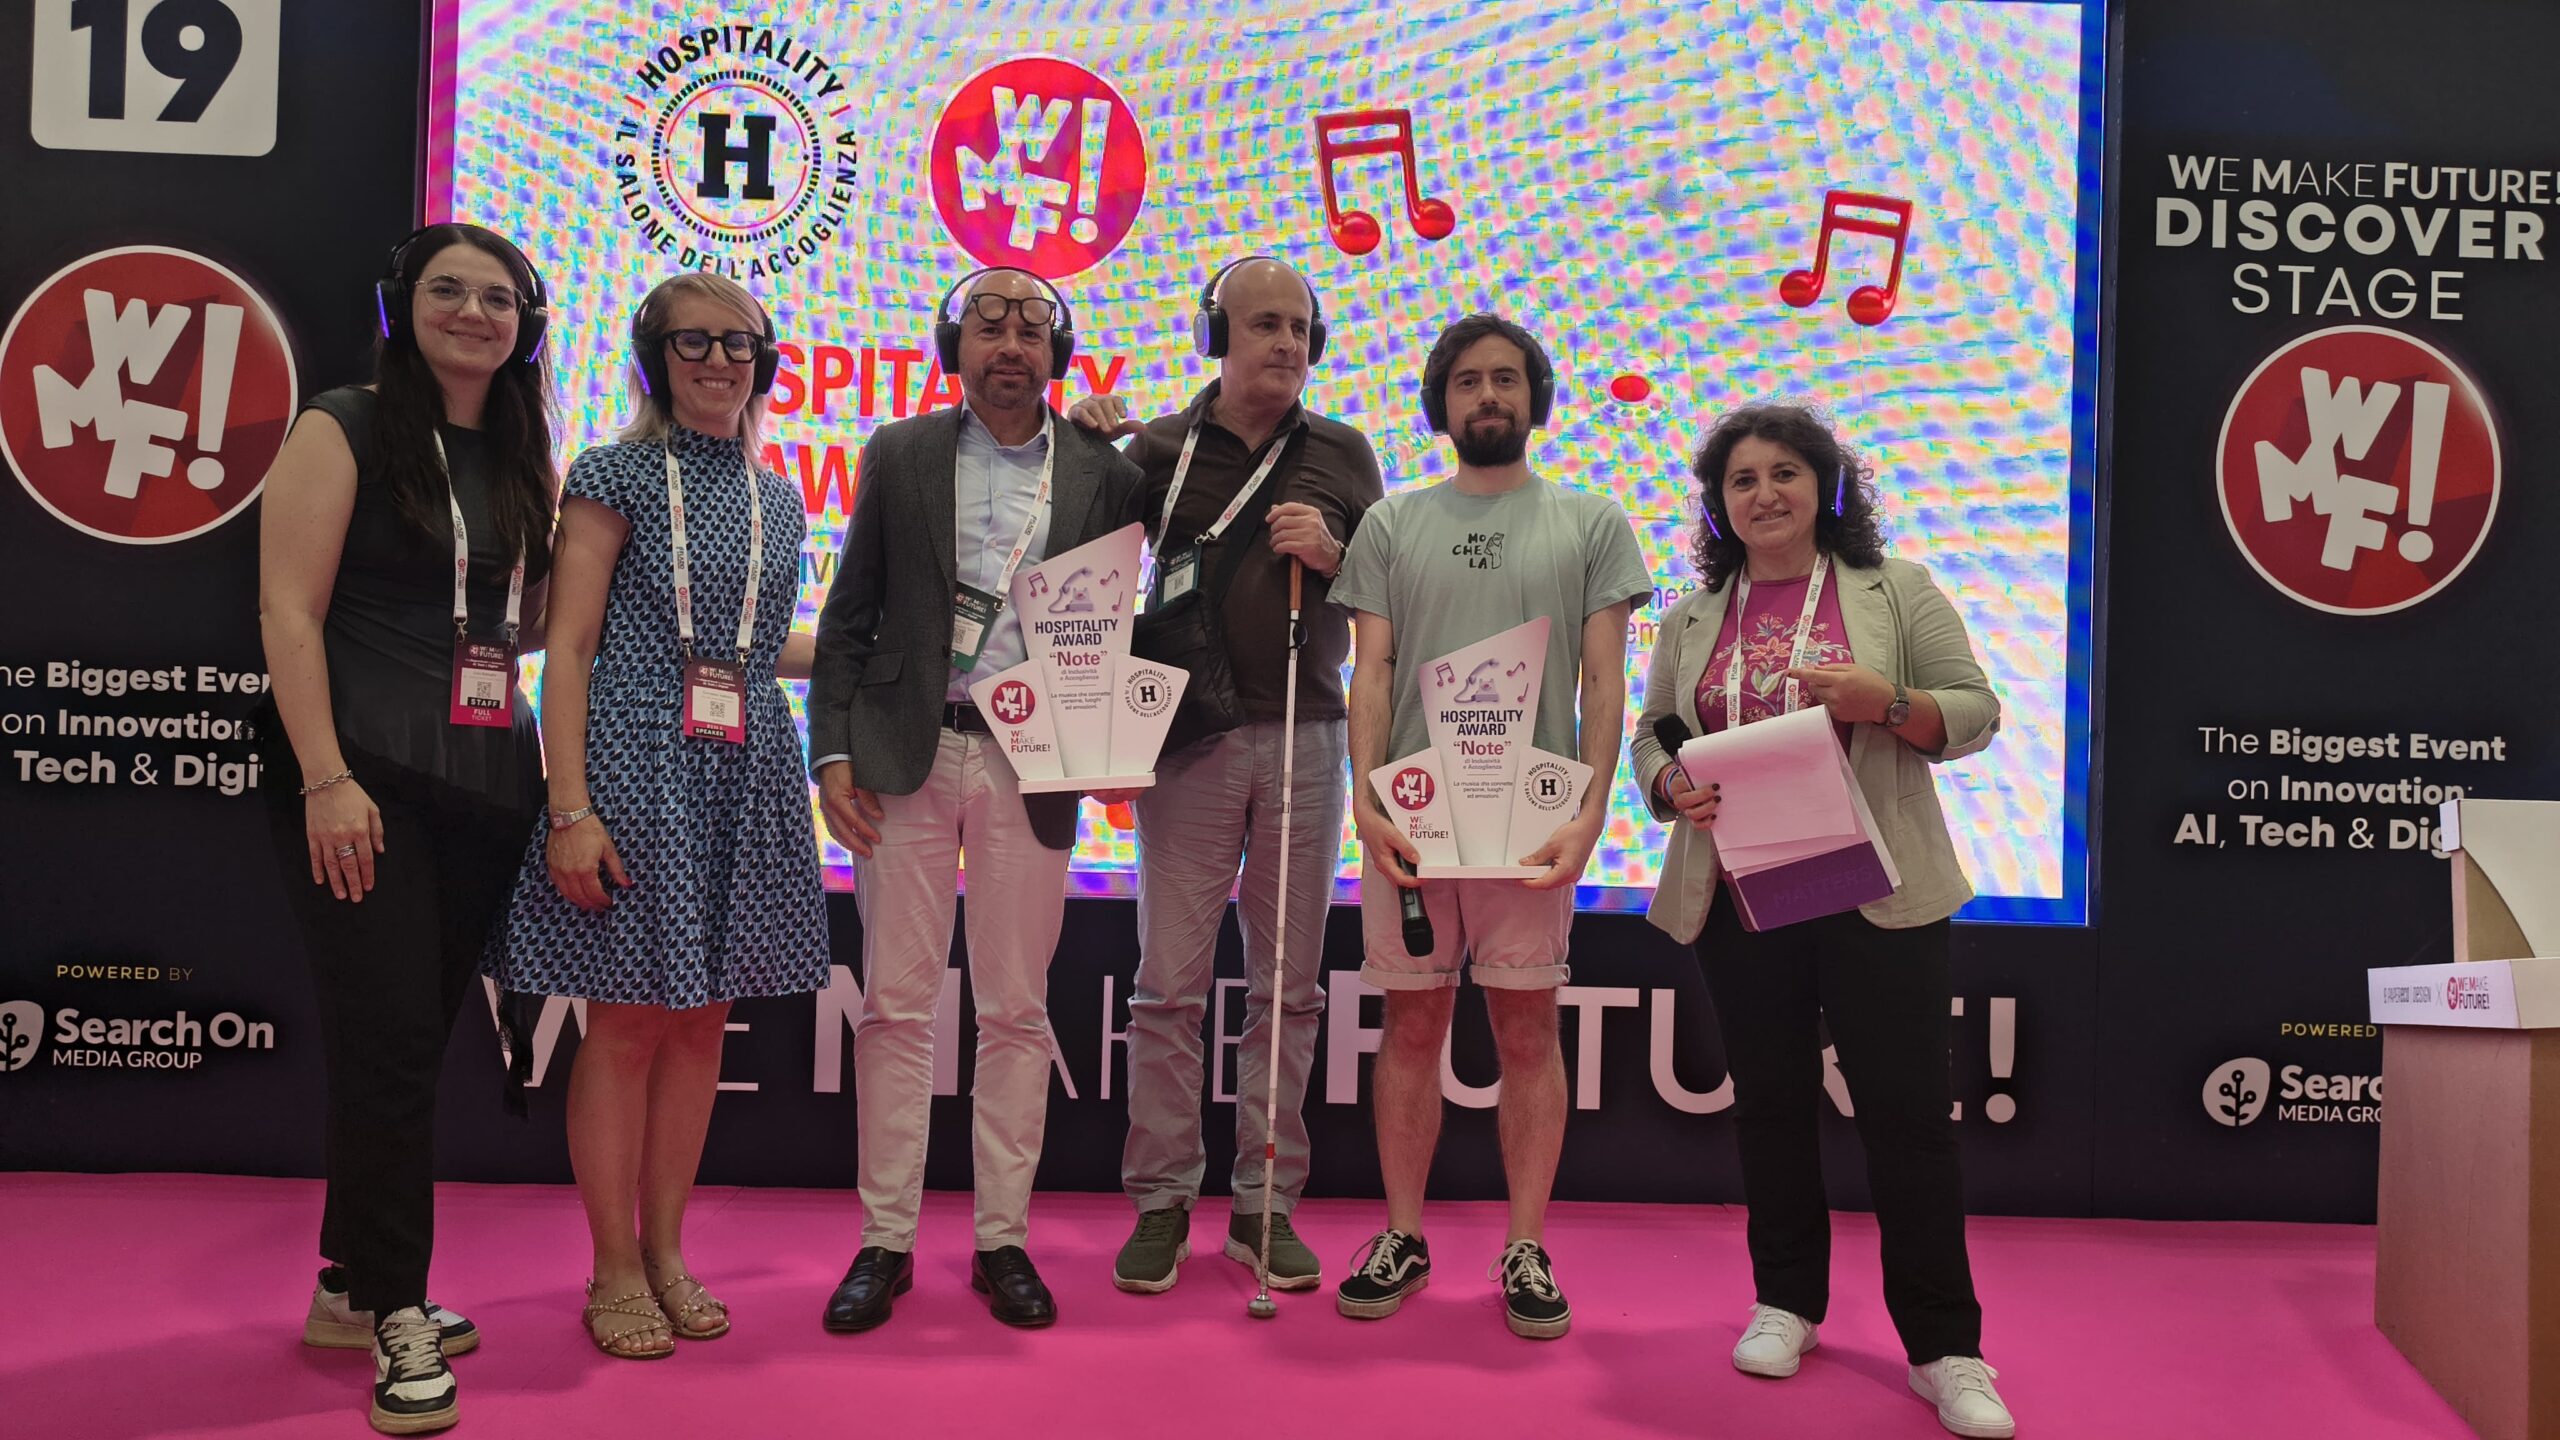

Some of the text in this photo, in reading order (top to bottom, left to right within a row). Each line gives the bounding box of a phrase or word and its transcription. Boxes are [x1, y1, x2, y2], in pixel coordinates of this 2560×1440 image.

[70, 0, 243, 122] 19
[637, 25, 844, 91] HOSPITALITY
[617, 117, 639, 142] IL
[697, 112, 776, 200] H
[2168, 154, 2240, 192] WE
[2252, 158, 2376, 198] MAKE
[616, 153, 677, 255] SALONE
[2155, 197, 2544, 261] DISCOVER
[2231, 262, 2464, 321] STAGE
[1468, 533, 1486, 544] MO
[1452, 545, 1482, 555] CHE
[1469, 557, 1487, 569] LA
[1035, 619, 1118, 634] HOSPITALITY
[1052, 633, 1102, 646] AWARD
[47, 660, 187, 697] Biggest
[1127, 669, 1167, 684] HOSPITALITY
[1140, 685, 1157, 703] H
[470, 698, 497, 707] STAFF
[2, 713, 45, 734] on
[1440, 710, 1523, 723] HOSPITALITY
[695, 728, 724, 736] SPEAKER
[1010, 729, 1025, 738] WE
[1457, 723, 1507, 736] AWARD
[1010, 737, 1035, 745] MAKE
[1010, 744, 1050, 753] FUTURE!
[2198, 727, 2506, 763] The Biggest Event
[14, 750, 116, 784] Tech
[130, 753, 158, 785] &
[1528, 762, 1569, 776] HOSPITALITY
[1540, 779, 1556, 795] H
[2228, 775, 2464, 805] on Innovation
[1410, 816, 1424, 824] WE
[1410, 823, 1433, 831] MAKE
[1410, 830, 1449, 839] FUTURE!
[2173, 813, 2227, 849] AI,
[2239, 815, 2335, 849] Tech
[2348, 817, 2375, 849] &
[57, 965, 193, 981] POWERED BY
[2458, 993, 2490, 1009] FUTURE!
[54, 1008, 274, 1048] Search On
[2281, 1023, 2378, 1037] POWERED
[52, 1049, 202, 1069] MEDIA GROUP
[2279, 1105, 2343, 1122] MEDIA
